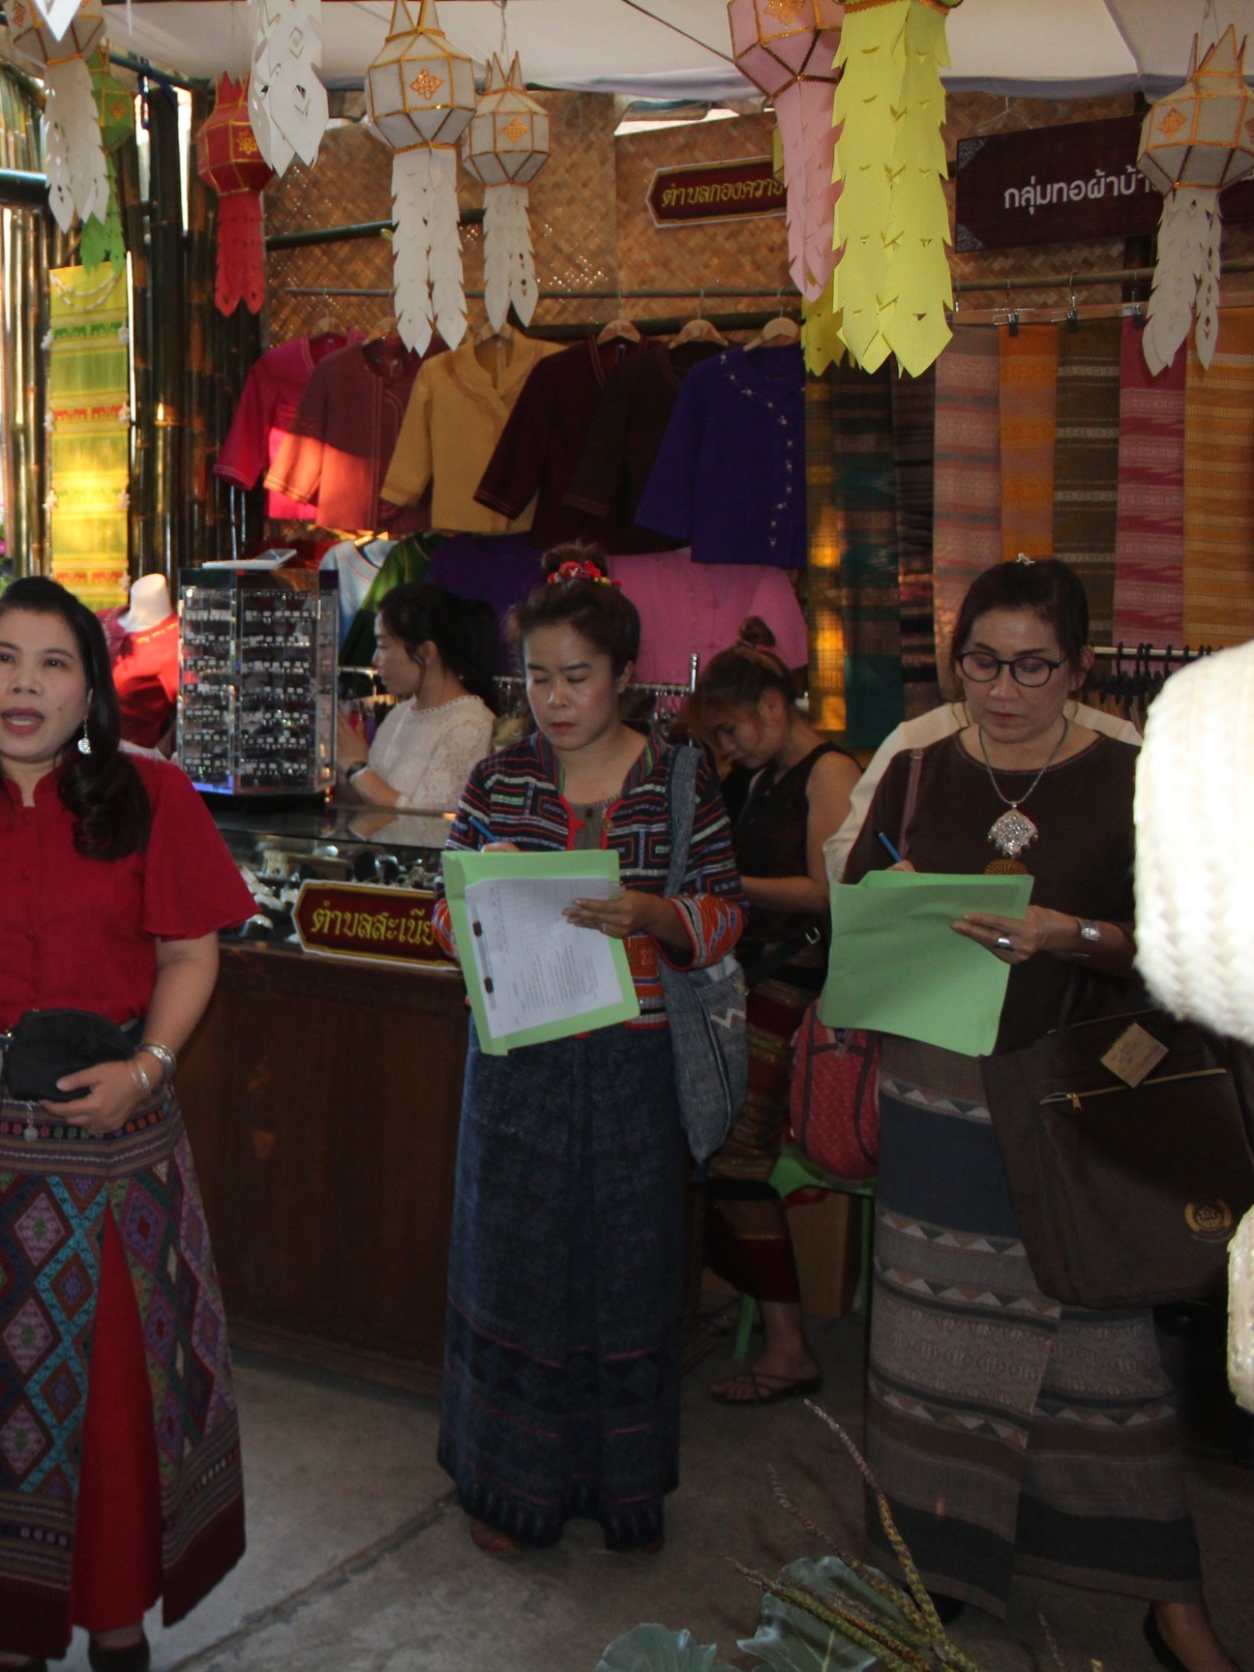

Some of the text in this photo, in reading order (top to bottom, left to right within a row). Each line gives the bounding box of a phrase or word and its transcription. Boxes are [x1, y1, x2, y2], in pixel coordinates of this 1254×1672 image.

[1003, 165, 1160, 216] กลุ่มทอผ้าบ้า
